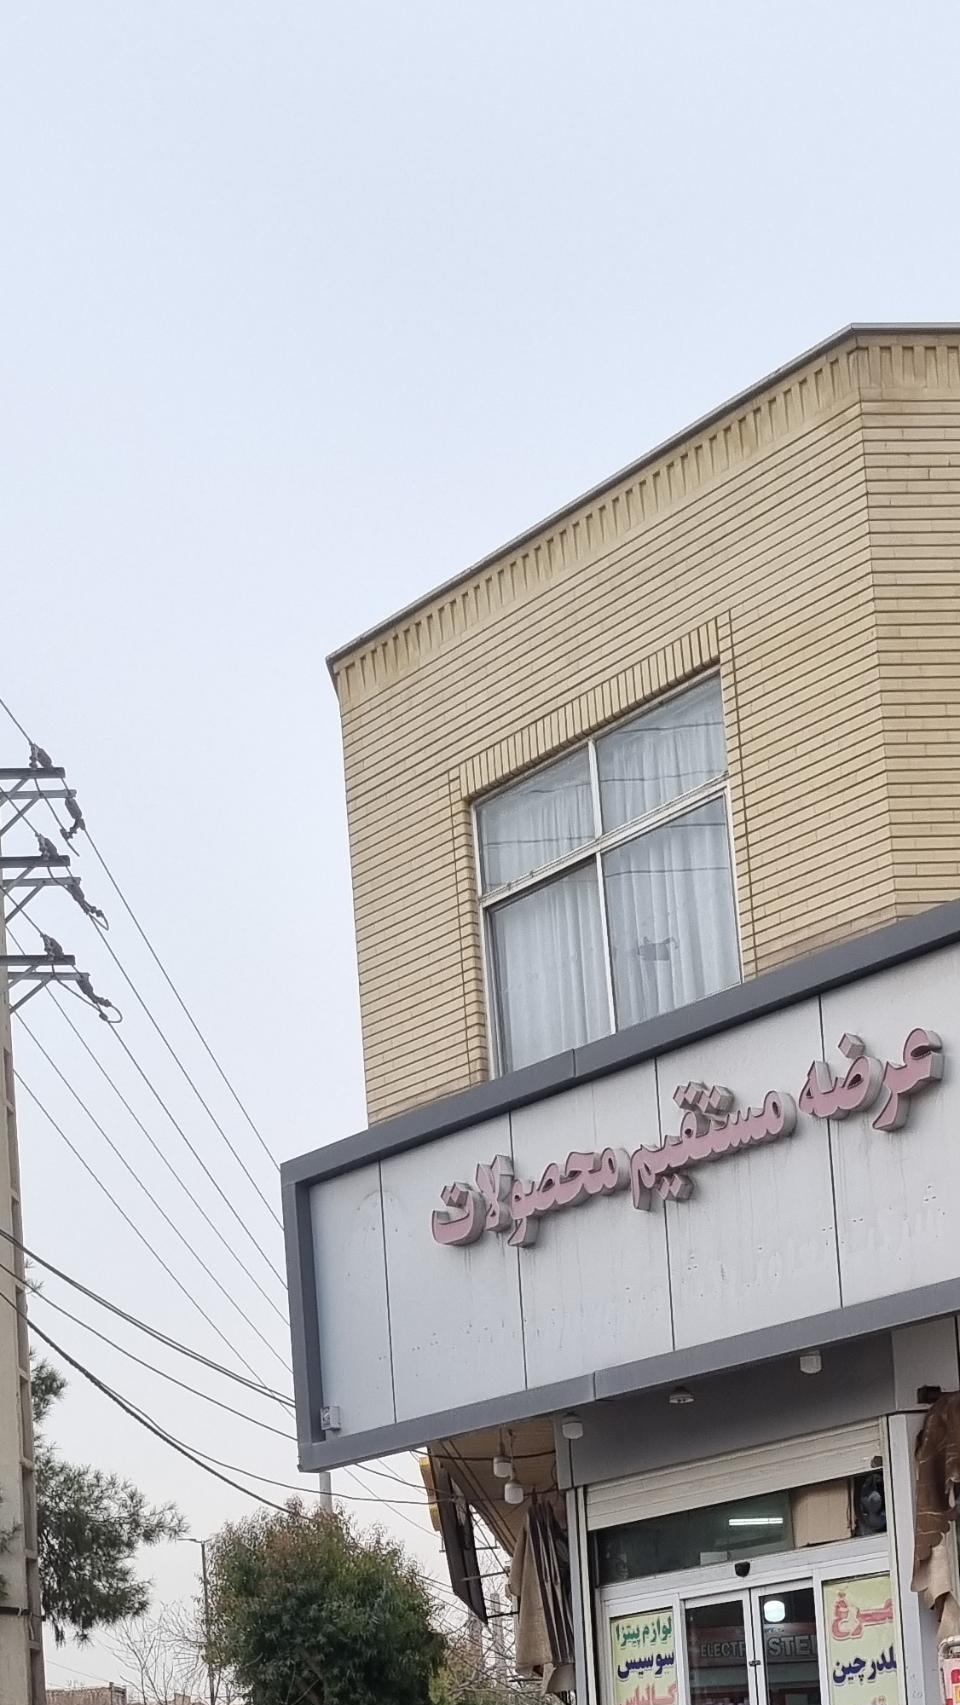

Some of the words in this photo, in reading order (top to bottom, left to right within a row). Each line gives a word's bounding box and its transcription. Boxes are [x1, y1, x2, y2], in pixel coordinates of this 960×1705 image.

[798, 1027, 944, 1132] عرضه
[629, 1080, 797, 1212] مستقیم
[430, 1147, 633, 1248] محصولات
[615, 1622, 641, 1648] پیتزا
[642, 1615, 673, 1645] لوازم
[617, 1650, 675, 1680] سوسیس
[832, 1645, 897, 1685] لدرچین
